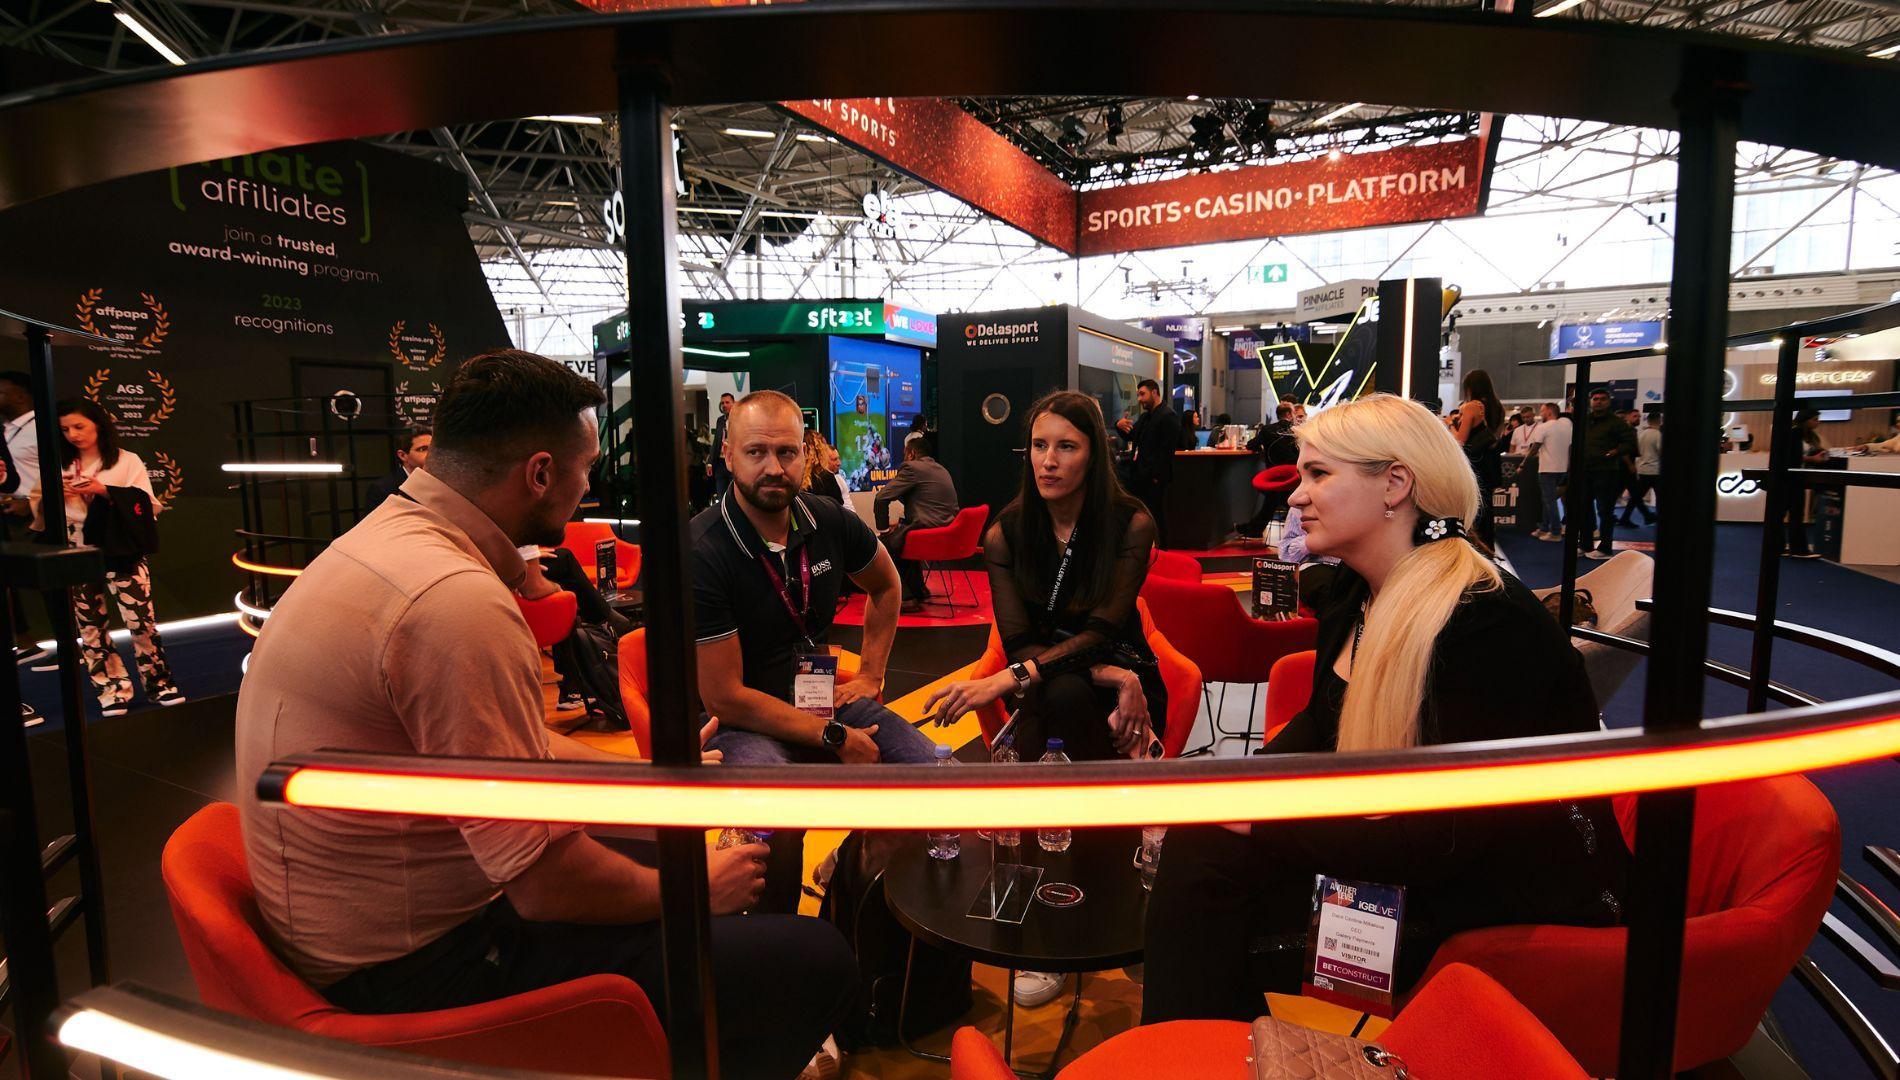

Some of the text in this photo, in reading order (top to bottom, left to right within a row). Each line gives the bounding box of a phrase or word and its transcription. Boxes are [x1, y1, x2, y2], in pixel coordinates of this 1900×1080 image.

[841, 102, 896, 147] SPORTS
[201, 178, 347, 226] affiliates
[1088, 165, 1466, 232] SPORTS CASINO PLATFORM
[223, 225, 256, 243] join
[260, 232, 273, 246] a
[168, 241, 309, 276] award-winning
[261, 293, 303, 310] 2023
[1302, 288, 1345, 307] PINNACLE
[95, 306, 149, 321] affpapa
[110, 324, 138, 332] winner
[234, 313, 335, 335] recognitions
[909, 318, 935, 335] LOVE
[976, 319, 1039, 337] Delasport
[115, 332, 135, 340] 2023
[401, 335, 435, 345] casino.org
[979, 338, 1010, 346] DELIVER
[1011, 336, 1039, 344] SPORTS
[1243, 349, 1261, 360] LEV
[116, 384, 144, 395] AGS
[404, 395, 437, 405] affpapa
[811, 559, 832, 575] BOSS
[1263, 561, 1296, 572] Delasport
[1329, 882, 1357, 896] ANOTHER
[1337, 892, 1355, 902] LEVEL
[1340, 951, 1368, 964] VISITOR
[1322, 961, 1384, 984] BETCONSTRUCT
